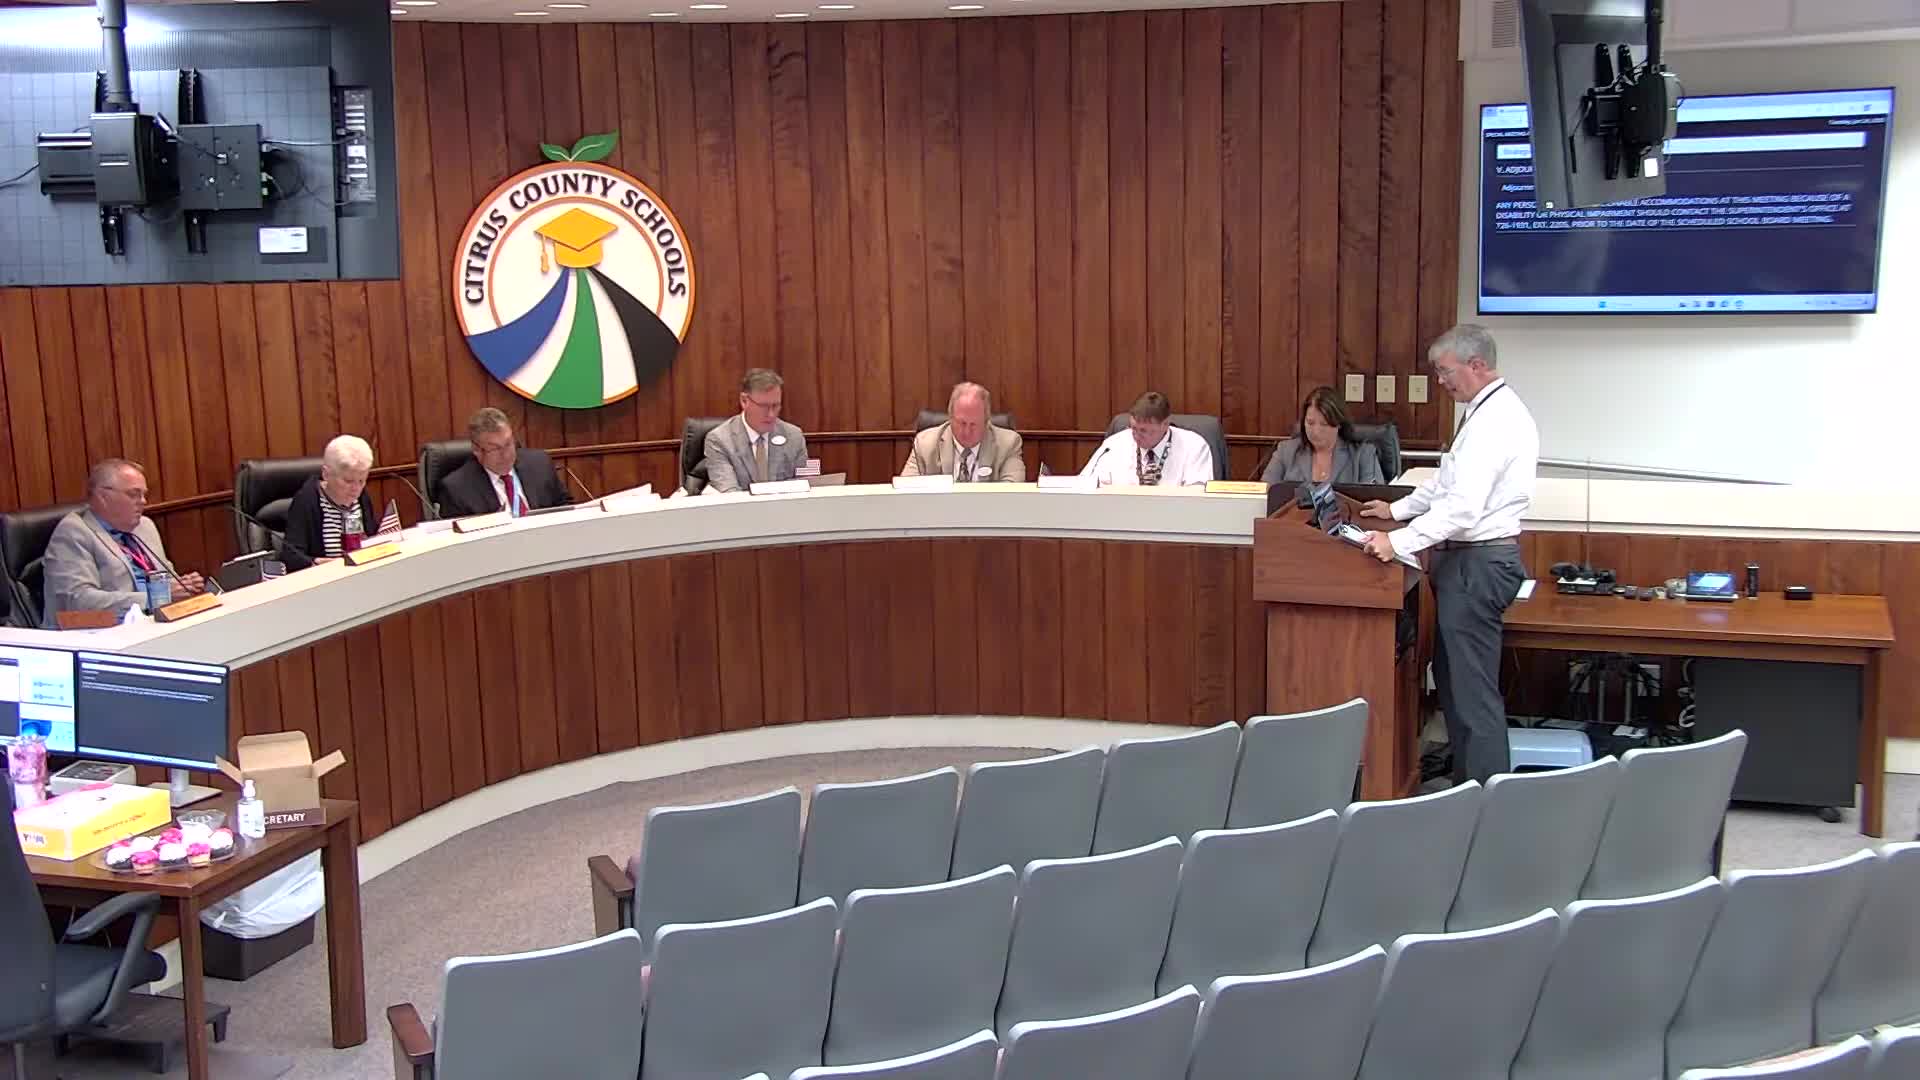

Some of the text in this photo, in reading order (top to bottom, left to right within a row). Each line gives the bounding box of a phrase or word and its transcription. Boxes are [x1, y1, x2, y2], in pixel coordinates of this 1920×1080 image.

[1496, 201, 1511, 209] ANY
[1513, 201, 1536, 209] PERSO
[1639, 196, 1718, 206] ACCOMMODATIONS
[1496, 210, 1535, 219] DISABILITY
[1550, 209, 1585, 218] PHYSICAL
[1587, 208, 1635, 217] IMPAIRMENT
[1637, 207, 1670, 216] SHOULD
[1671, 206, 1708, 215] CONTACT
[1710, 206, 1726, 214] THE
[1572, 220, 1597, 228] PRIOR
[1598, 219, 1608, 227] TO
[1609, 219, 1624, 227] THE
[1625, 219, 1646, 227] DATE
[1647, 218, 1659, 226] OF
[1660, 218, 1675, 226] THE
[1676, 217, 1725, 226] SCHEDULED
[1726, 217, 1758, 225] SCHOOL
[1760, 216, 1790, 224] BOARD
[465, 173, 686, 304] CITRUS COUNTY SCHOOLS
[264, 812, 306, 825] CRETARY
